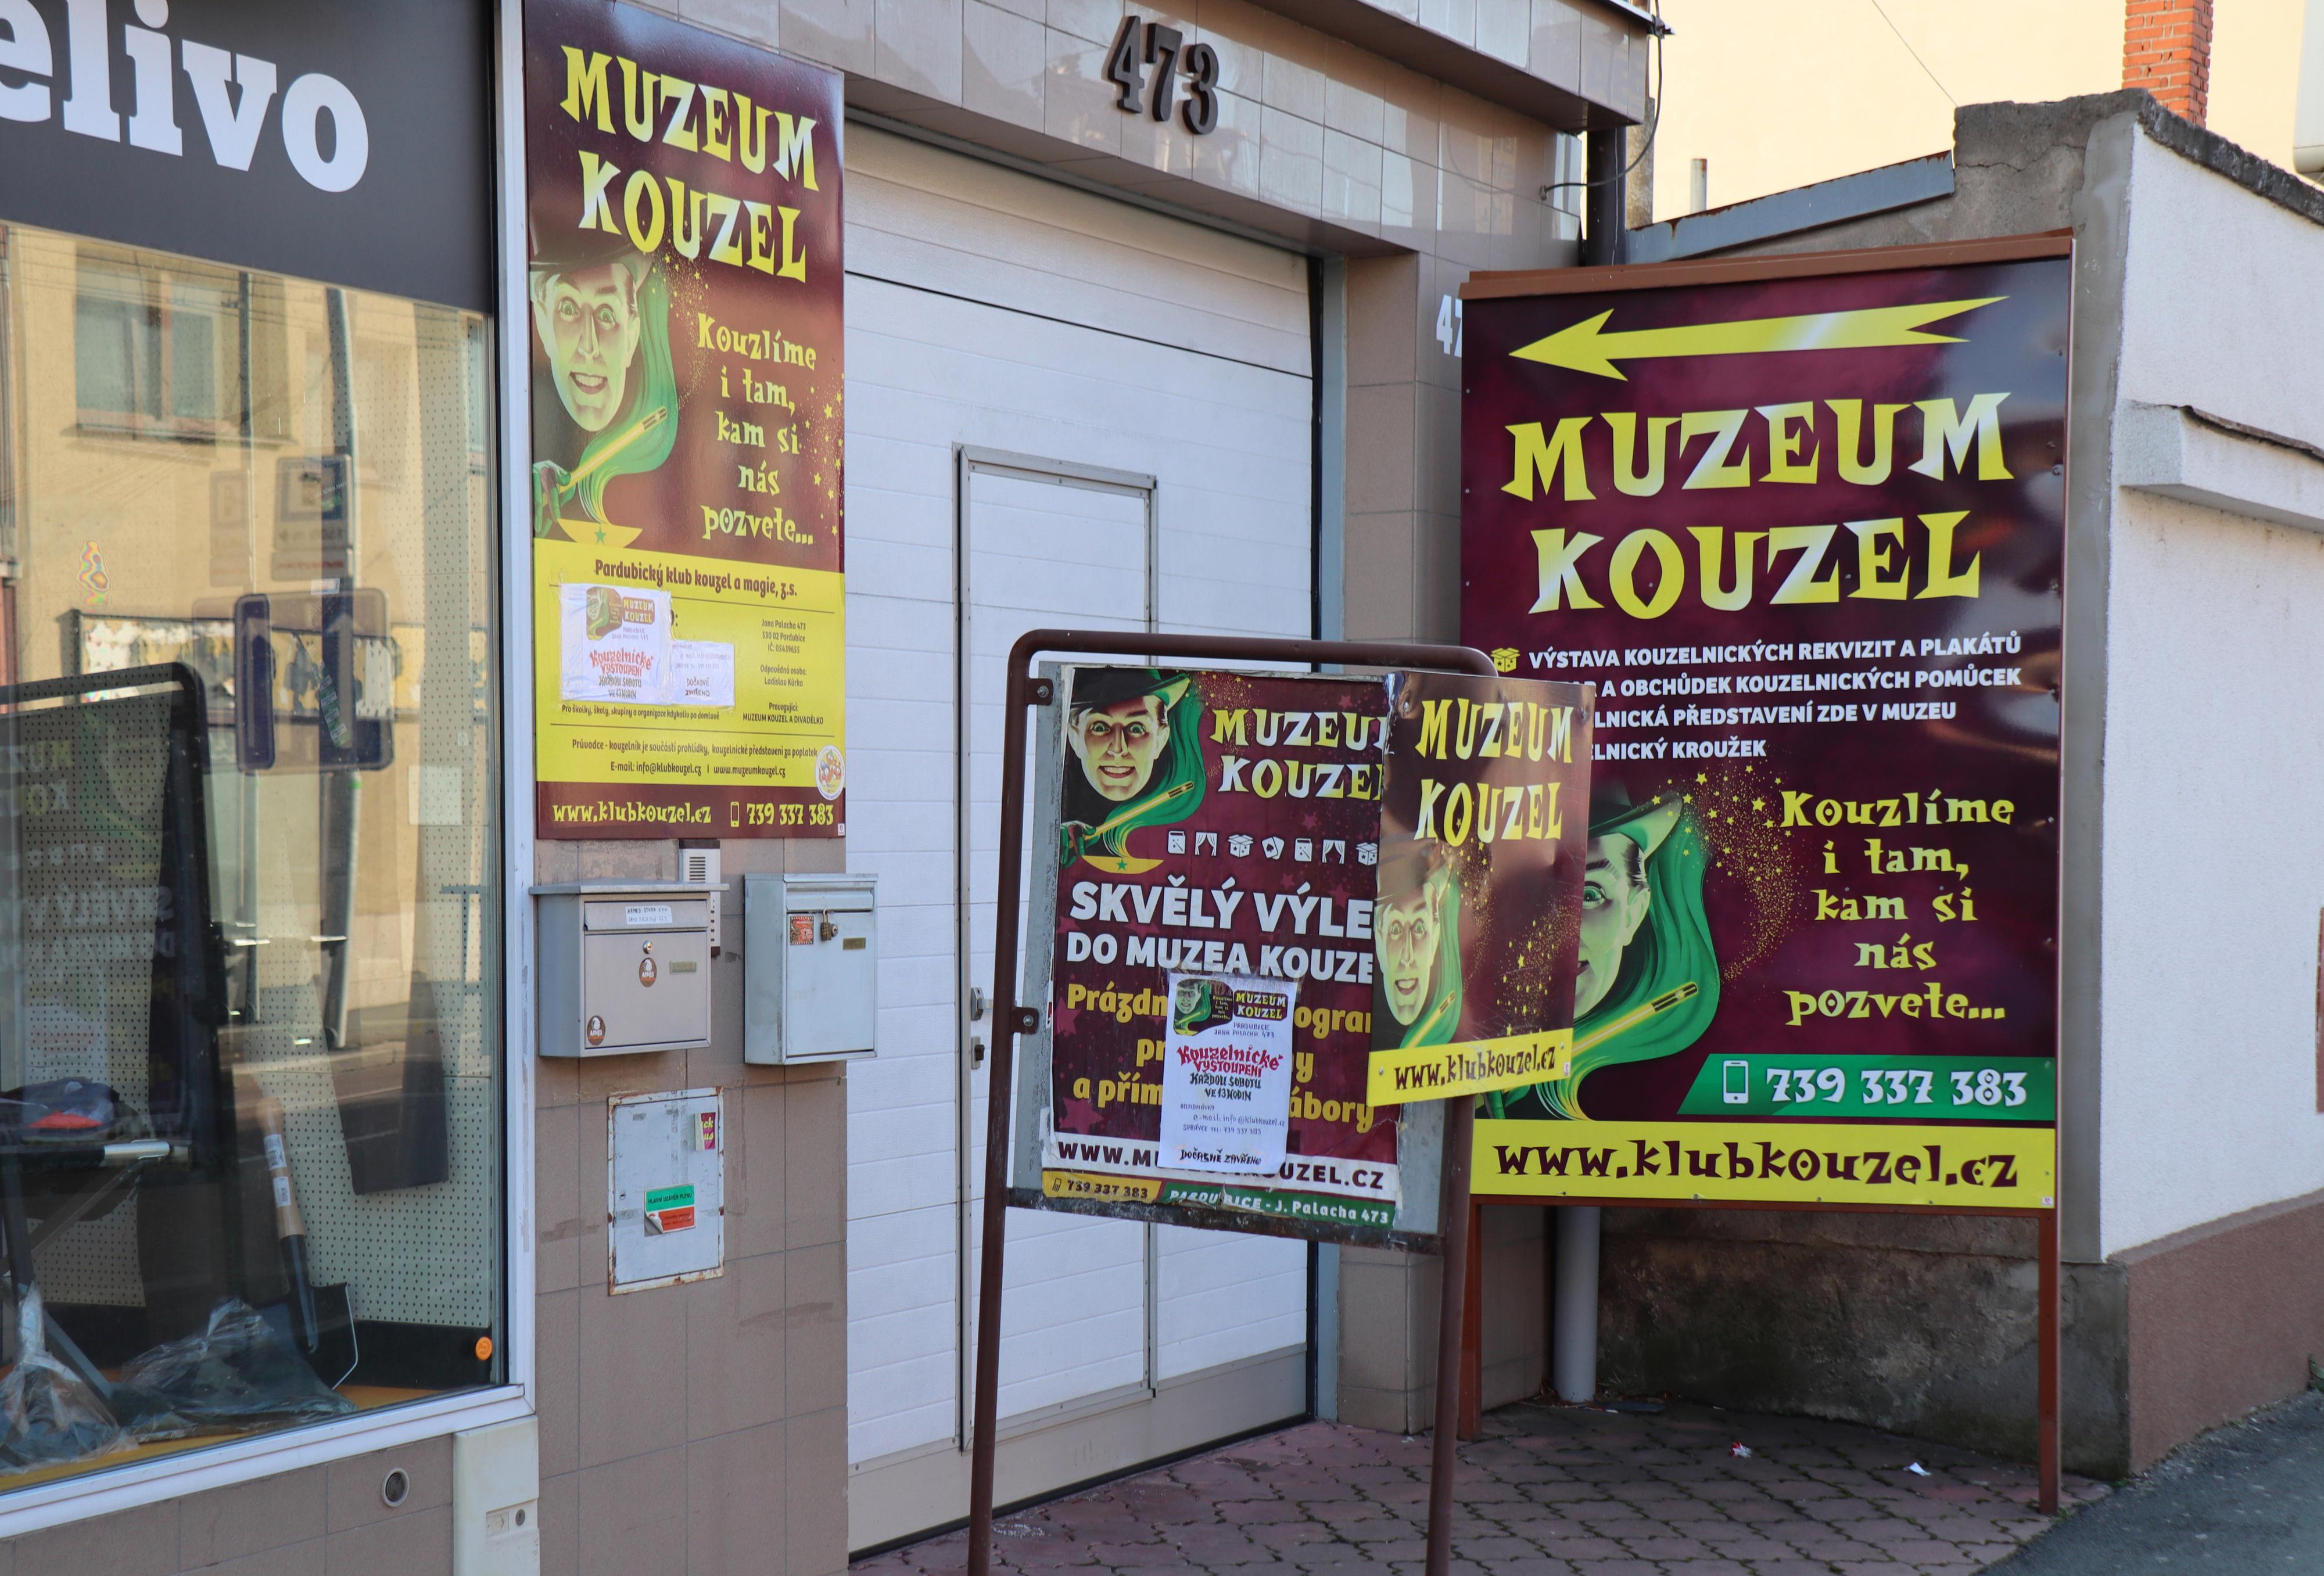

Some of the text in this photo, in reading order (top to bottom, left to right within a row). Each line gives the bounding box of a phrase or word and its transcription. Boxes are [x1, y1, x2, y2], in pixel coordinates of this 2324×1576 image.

[1107, 15, 1220, 135] 473
[0, 0, 369, 193] elivo
[560, 45, 819, 192] MUZEUM
[578, 150, 806, 283] KOUZEL
[697, 313, 817, 370] Kouzlíme
[720, 365, 795, 416] i tam,
[714, 411, 801, 455] kam si
[1500, 392, 2015, 502] MUZEUM
[737, 459, 779, 496] nás
[700, 504, 814, 545] pozvete...
[1527, 509, 1980, 620] KOUZEL
[594, 559, 798, 601] Pardubický klub kouzel a magie, z.s.
[623, 598, 654, 612] MUZEUM
[625, 611, 652, 623] KOUZEL
[762, 619, 806, 630] Jana Palacha 473
[762, 631, 806, 642] 530 02 Pardubice
[589, 646, 654, 670] Kouzelnické
[776, 644, 800, 654] 05439655
[1529, 630, 2021, 670] VÝSTAVA KOUZELNICKÝCH REKVIZIT A PLAKÁTŮ
[760, 663, 807, 676] Odpovědná osoba:
[765, 677, 804, 687] Ladislav Kůrka
[1601, 680, 1617, 697] A
[1620, 672, 1732, 697] OBCHŮDEK
[1735, 666, 1910, 694] KOUZELNICKÝCH
[1915, 663, 2022, 688] POMŮCEK
[562, 704, 572, 713] Pro
[572, 704, 593, 716] školky,
[594, 705, 610, 717] školy,
[611, 706, 632, 718] skupiny
[637, 708, 666, 720] organizace
[666, 708, 690, 720] kdykoliv
[690, 712, 697, 721] po
[697, 710, 720, 720] domluvě
[743, 713, 824, 725] MUZEUM KOUZEL A DIVADÉLKO
[769, 702, 799, 713] Provozující:
[1674, 699, 1813, 726] PŘEDSTAVENÍ
[1817, 704, 1858, 723] ZDE
[1862, 703, 1877, 721] V
[1882, 702, 1957, 720] MUZEU
[1415, 698, 1574, 764] MUZEUM
[572, 738, 818, 759] Průvodce kouzelník je součástí prohlídky, kouzelnické představení za poplatek
[1591, 735, 1767, 761] LNICKÝ KROUŽEK
[610, 761, 786, 778] E-mail: info@klubkouzel.cz www.muzeumkouzel.cz
[552, 800, 834, 825] www.klubkouzel.cz 739 337 383
[1413, 778, 1563, 848] KOUZEL
[1779, 788, 2015, 828] Kouzlíme
[1822, 838, 1970, 881] i tam,
[1070, 874, 1373, 939] SKVĚLÝ VÝLE
[1810, 886, 1979, 923] kam si
[1067, 931, 1118, 965] DO
[1125, 935, 1250, 975] MUZEA
[1853, 932, 1937, 971] nás
[1235, 992, 1287, 1008] MUZEUM
[1236, 1005, 1283, 1020] KOUZEL
[1782, 982, 2006, 1026] pozvete...
[1232, 1029, 1259, 1037] PALACHA
[1261, 1030, 1275, 1039] 473
[1233, 1022, 1270, 1031] PARDUBICE
[1177, 1043, 1283, 1071] Kouzelnické
[1394, 1044, 1556, 1091] www.klubkouzel.cz
[1073, 1078, 1090, 1099] a
[1189, 1071, 1262, 1089] KAŽDOU SOBOTU
[1204, 1087, 1217, 1098] VE
[1766, 1067, 2028, 1107] 739 337 383
[1180, 1103, 1215, 1111] OBJEDNÁVKY
[1182, 1123, 1208, 1132] SPRÁVCE
[1223, 1126, 1235, 1134] 739
[1236, 1127, 1247, 1135] 337
[1179, 1146, 1263, 1165] DOČASNĚ ZAVŘENO
[1492, 1139, 2018, 1188] www.klubkouzel.cz
[648, 1196, 662, 1204] HLAVNÍ
[1067, 1179, 1090, 1191] 739
[1093, 1183, 1120, 1196] 337
[1123, 1186, 1149, 1199] 383
[1274, 1199, 1288, 1213] J.
[1292, 1200, 1357, 1220] Palacha
[1360, 1208, 1389, 1224] 473
